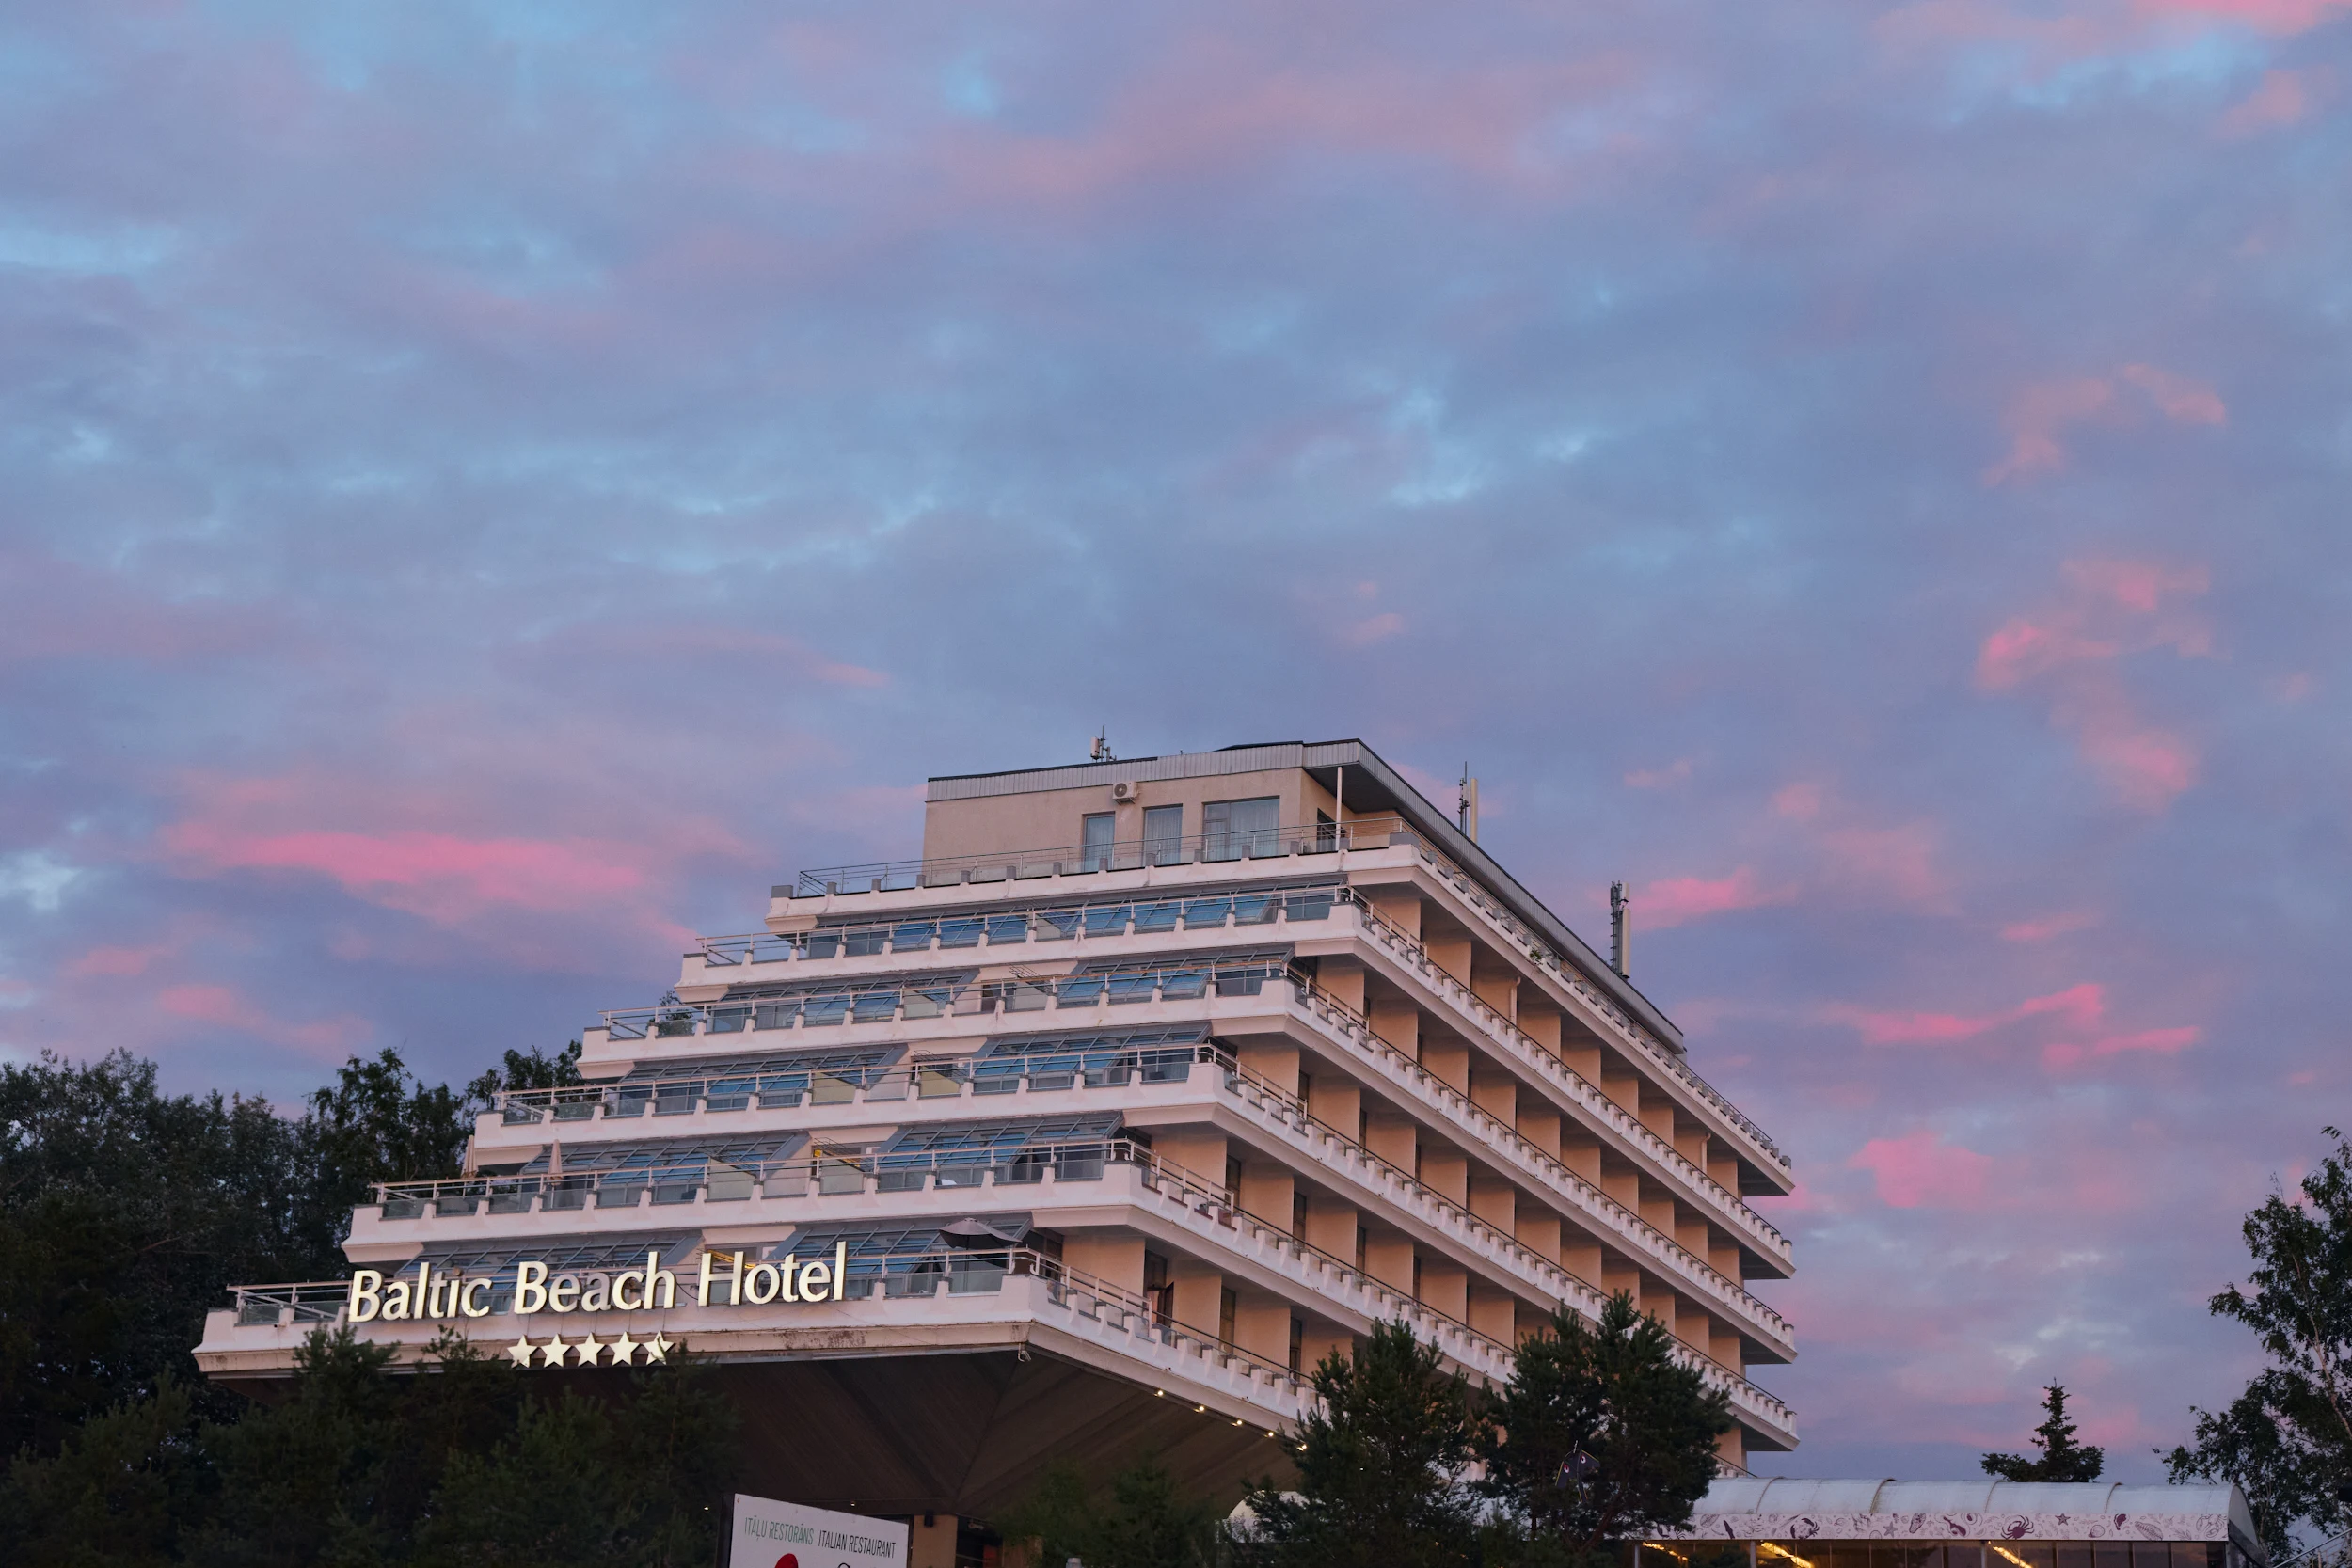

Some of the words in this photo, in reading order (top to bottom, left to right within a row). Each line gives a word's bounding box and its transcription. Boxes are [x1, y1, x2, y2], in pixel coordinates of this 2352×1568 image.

[349, 1261, 492, 1323] Baltic
[514, 1251, 675, 1314] Beach
[698, 1241, 847, 1307] Hotel
[744, 1515, 767, 1542] ITĀĻU
[769, 1522, 814, 1545] RESTORĀNS
[818, 1529, 847, 1550] ITALIAN
[849, 1534, 896, 1559] RESTAURANT
